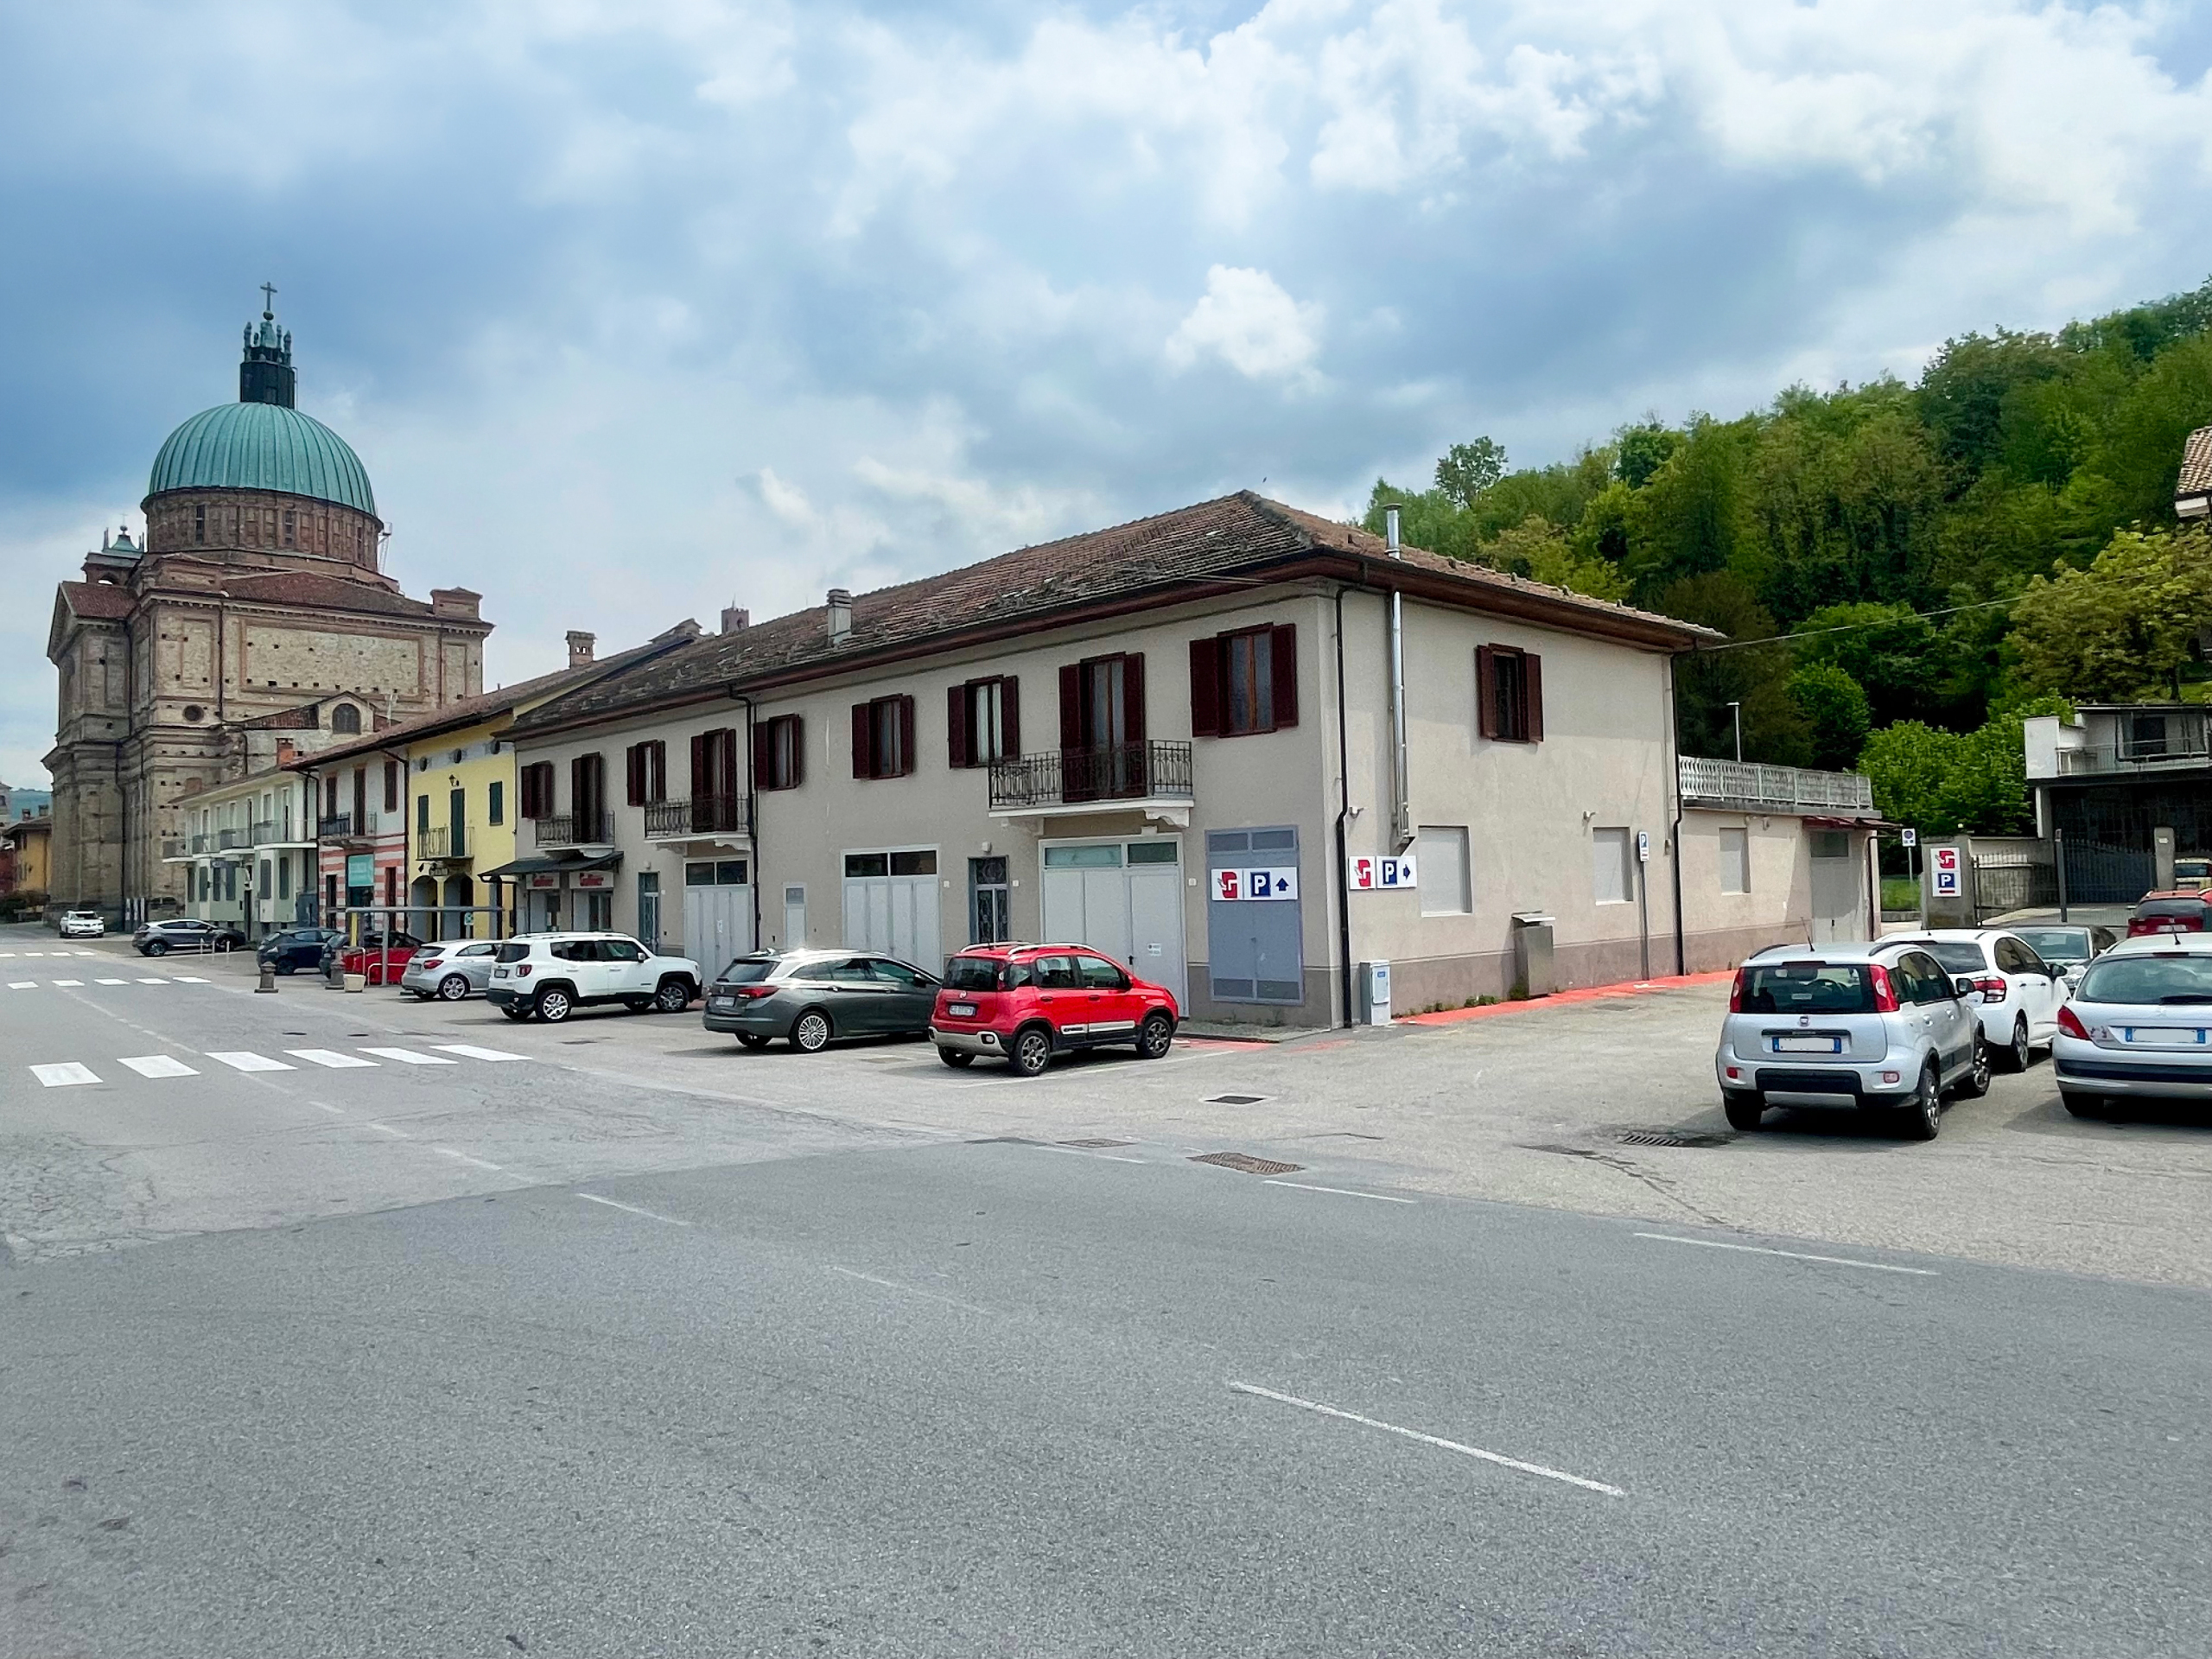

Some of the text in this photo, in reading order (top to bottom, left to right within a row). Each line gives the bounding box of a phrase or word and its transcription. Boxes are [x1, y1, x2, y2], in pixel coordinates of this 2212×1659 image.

[1385, 862, 1395, 882] P
[1941, 874, 1952, 887] P
[1254, 874, 1267, 894] P
